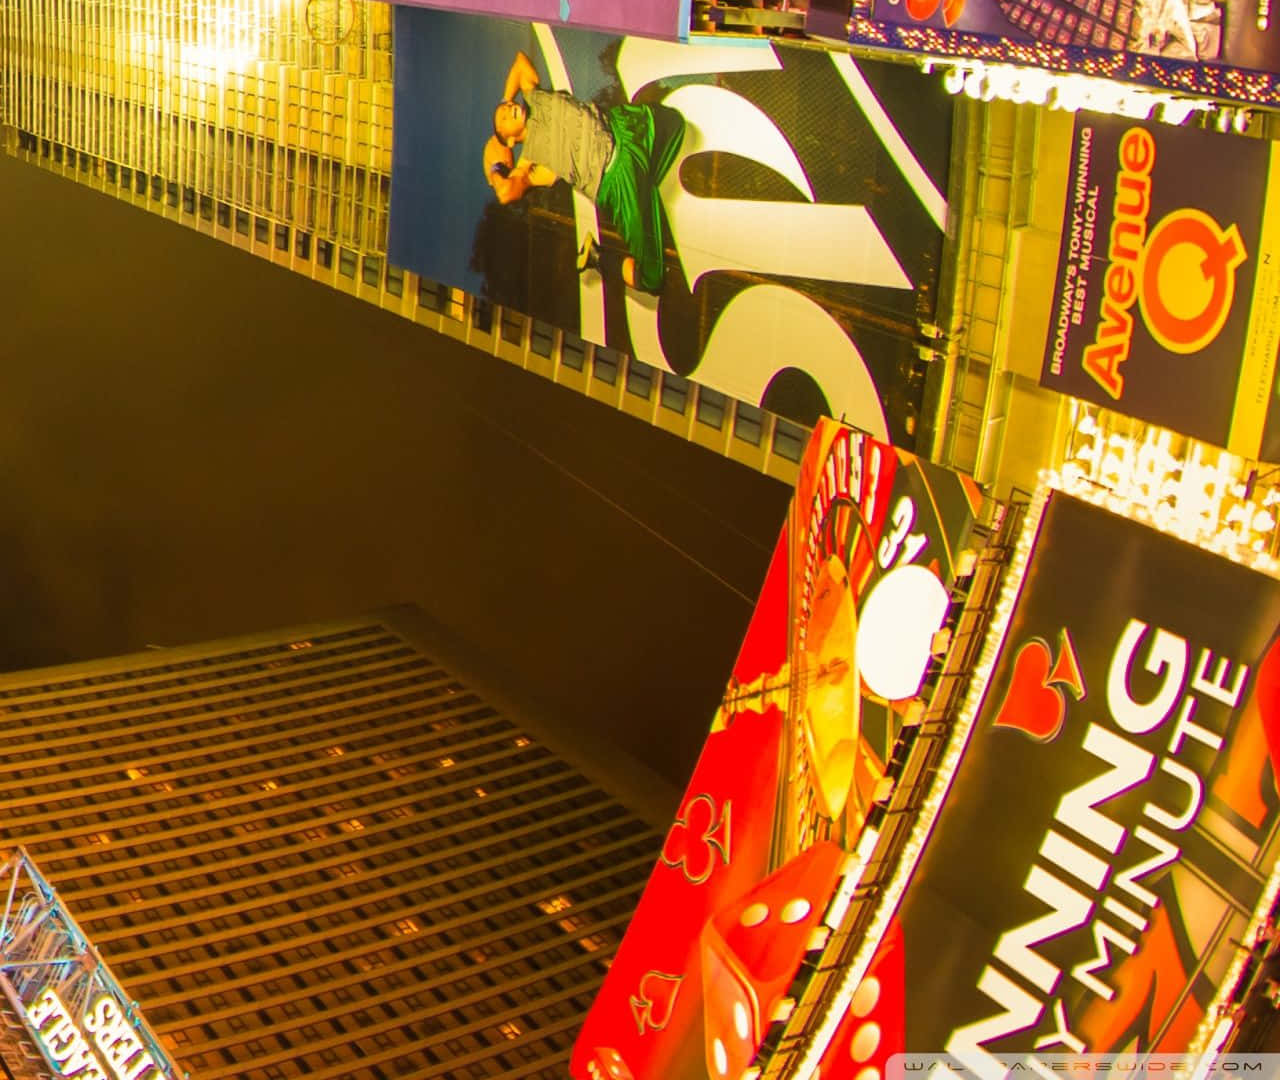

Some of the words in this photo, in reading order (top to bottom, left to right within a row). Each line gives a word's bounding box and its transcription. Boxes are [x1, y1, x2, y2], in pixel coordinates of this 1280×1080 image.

[1050, 264, 1078, 375] BROADWAY'S
[1071, 276, 1087, 324] BEST
[1079, 185, 1098, 270] MUSICAL
[1081, 125, 1155, 399] Avenue
[1139, 208, 1248, 353] Q
[1071, 648, 1249, 1002] MINUTE
